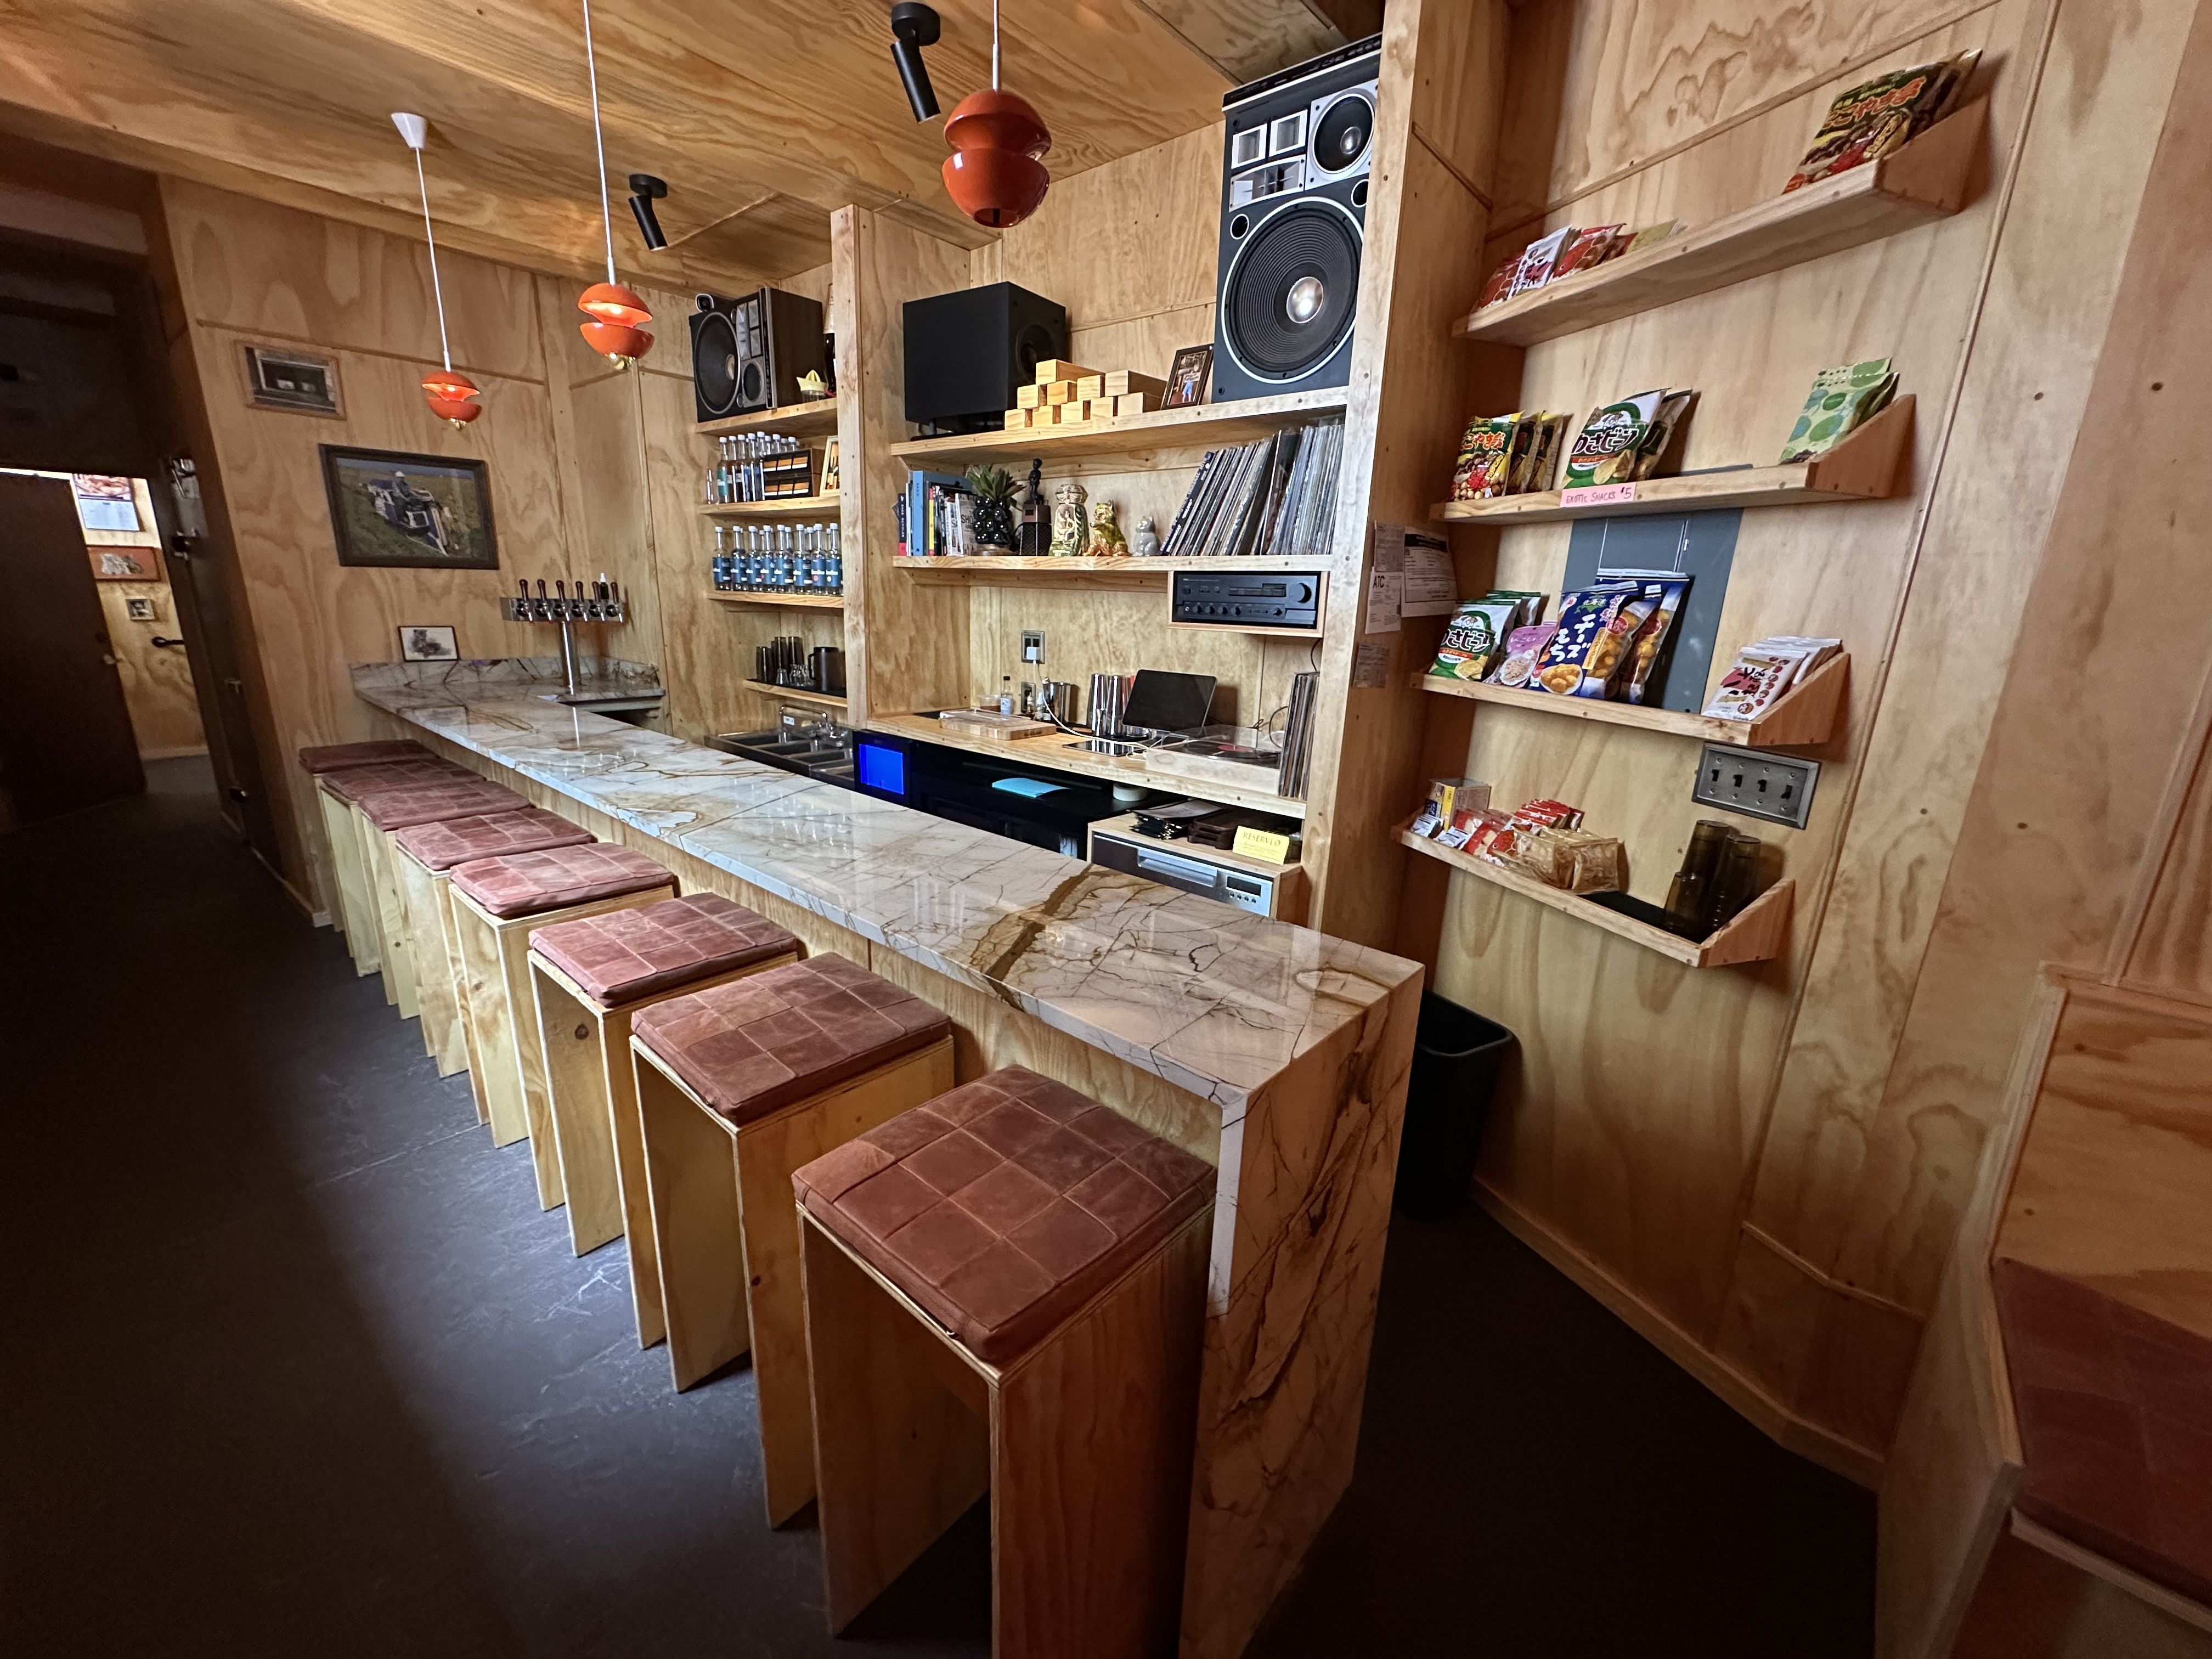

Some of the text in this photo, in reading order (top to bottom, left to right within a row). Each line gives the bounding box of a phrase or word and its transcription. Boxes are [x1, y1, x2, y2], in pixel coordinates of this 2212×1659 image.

[1566, 493, 1587, 504] EXOTIC
[1591, 492, 1616, 502] SNACKS
[1549, 628, 1570, 662] もち
[1566, 613, 1592, 659] チーズ
[1243, 832, 1280, 846] RESERVED
